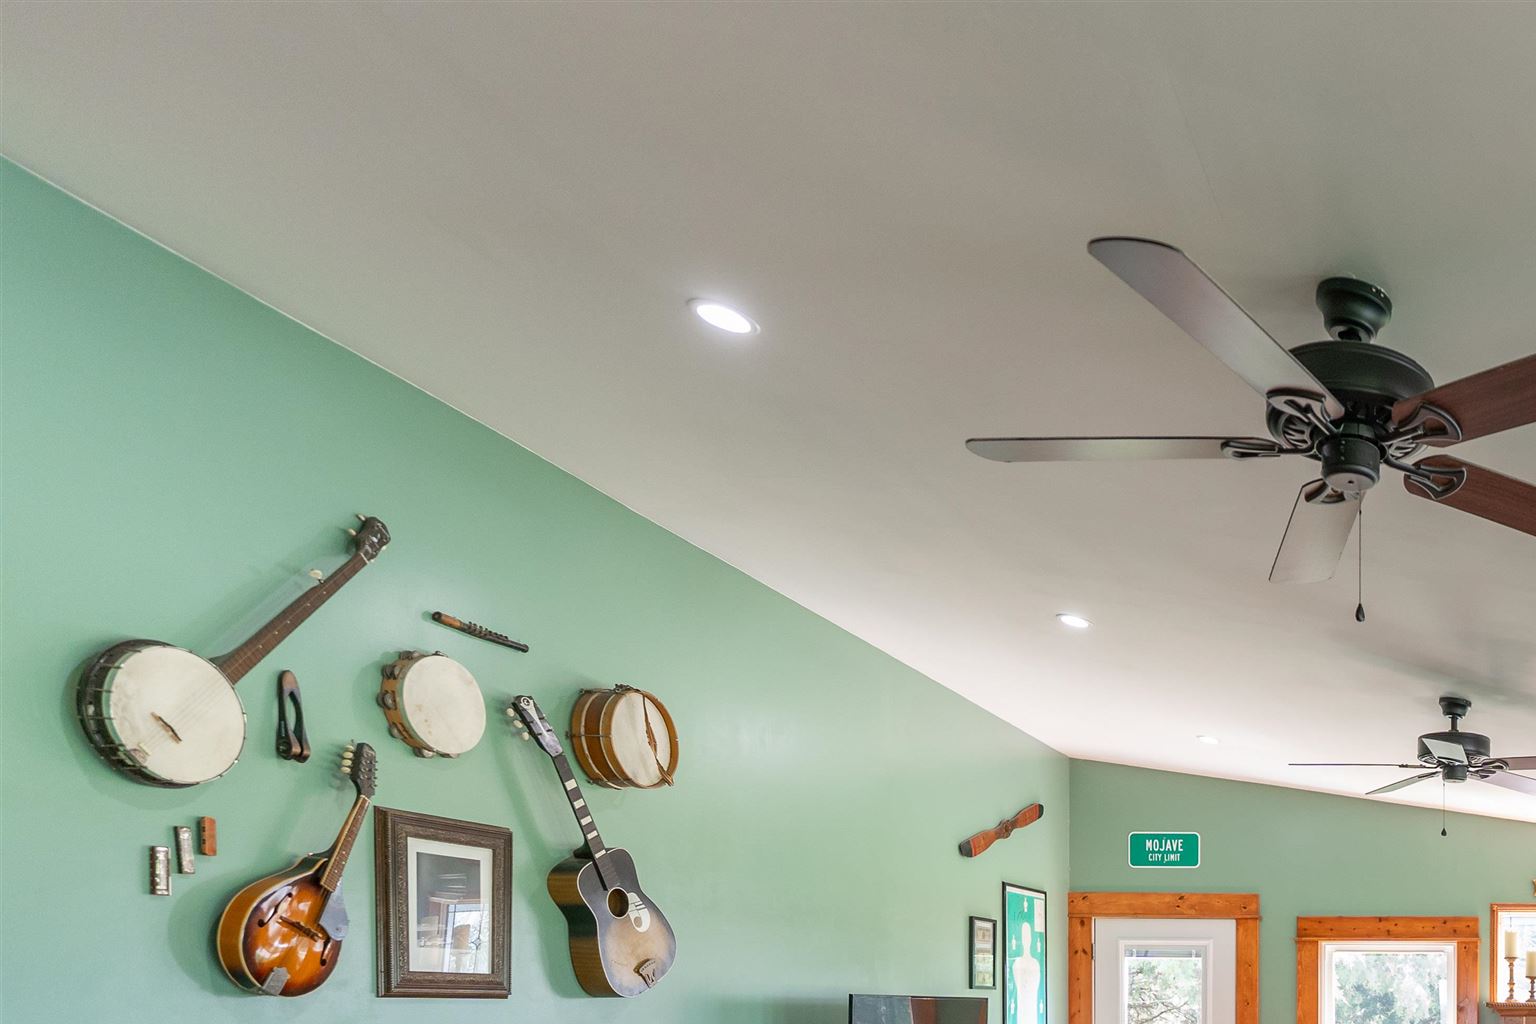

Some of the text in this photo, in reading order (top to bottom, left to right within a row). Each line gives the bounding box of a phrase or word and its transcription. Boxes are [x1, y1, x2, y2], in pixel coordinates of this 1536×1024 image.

[1145, 839, 1183, 851] MOJAVE
[1148, 853, 1180, 861] CITY LIMIT
